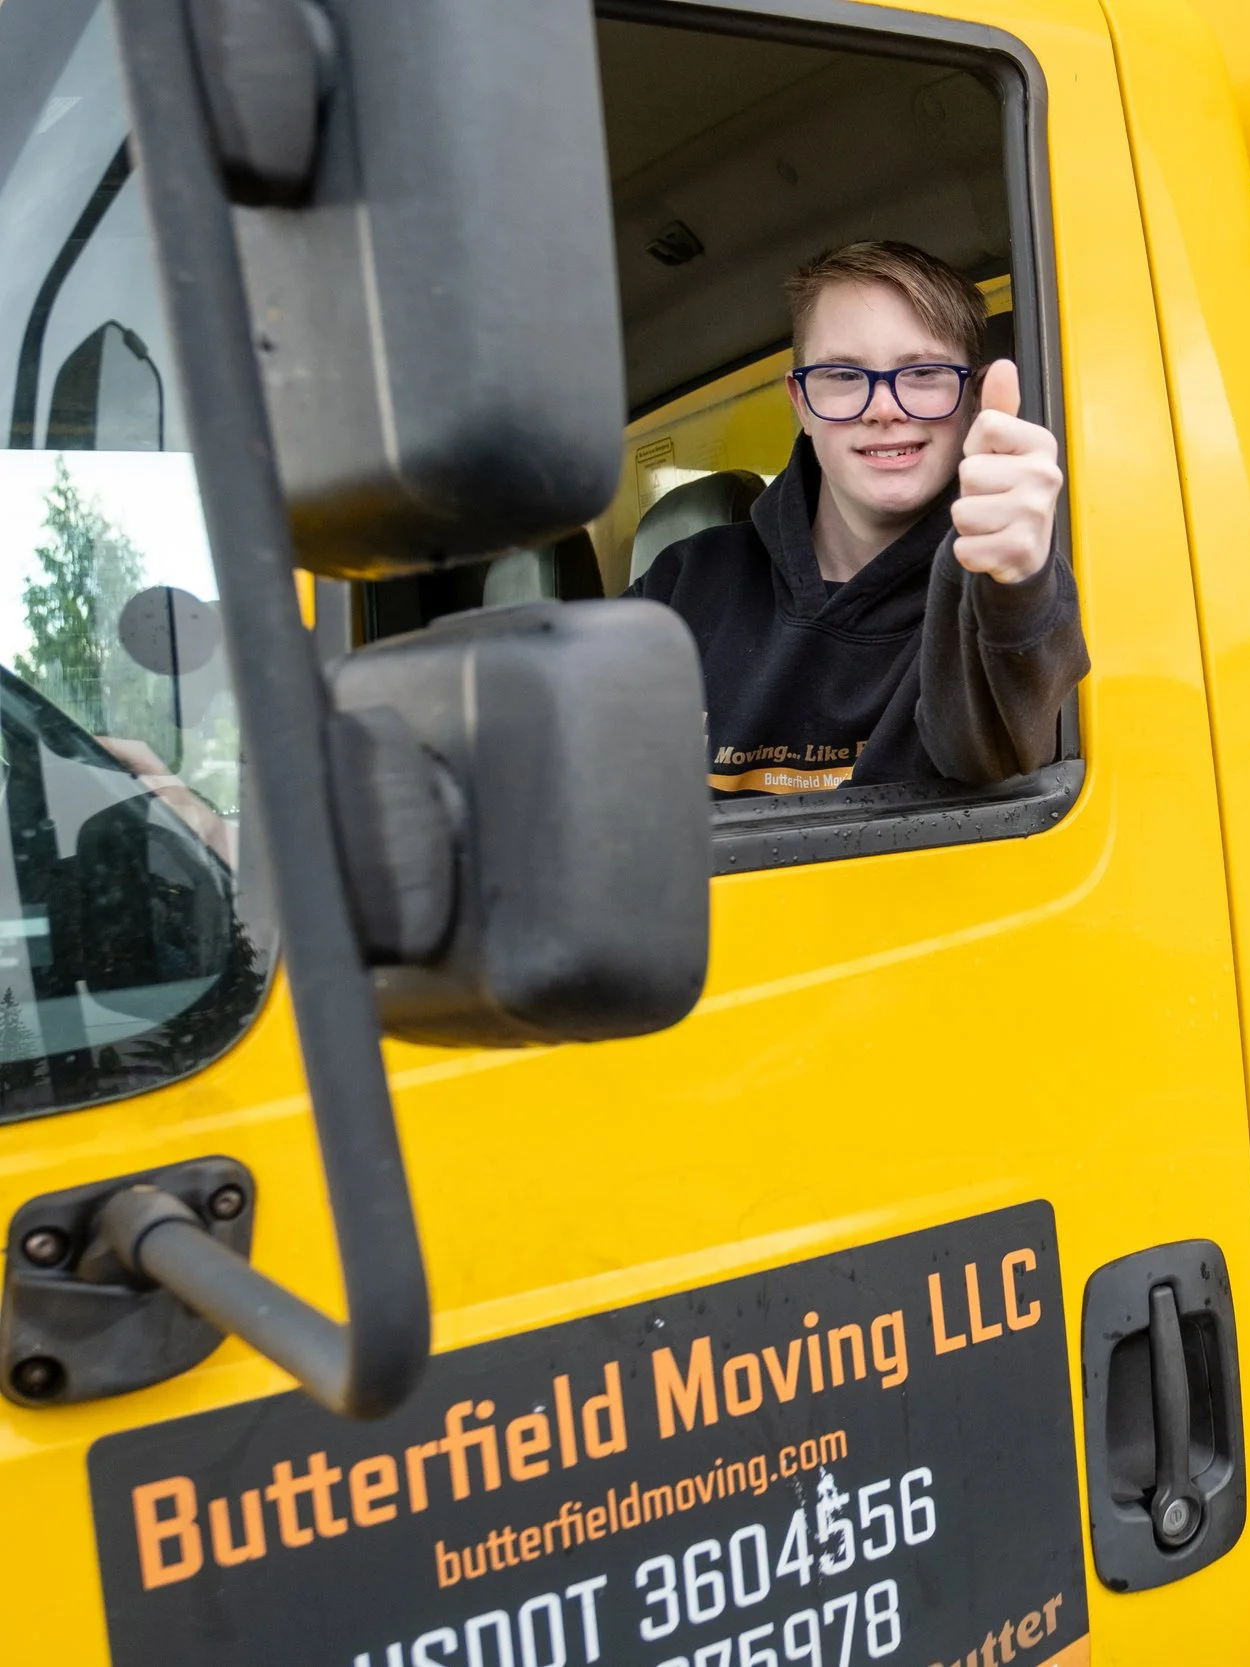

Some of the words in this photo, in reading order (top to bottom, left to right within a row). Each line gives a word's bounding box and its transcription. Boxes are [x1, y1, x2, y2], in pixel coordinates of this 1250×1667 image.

[714, 744, 800, 764] Moving...
[804, 744, 849, 762] Like
[764, 772, 820, 789] Butterfield
[823, 773, 849, 787] Mov
[132, 1360, 628, 1591] Butterfield
[650, 1310, 910, 1440] Moving
[927, 1247, 1042, 1356] LLC
[434, 1429, 848, 1589] butterfieldmoving.com
[354, 1574, 608, 1667] DOT
[635, 1466, 937, 1642] 3604556
[655, 1578, 902, 1667] 5978
[928, 1592, 1063, 1667] tter
